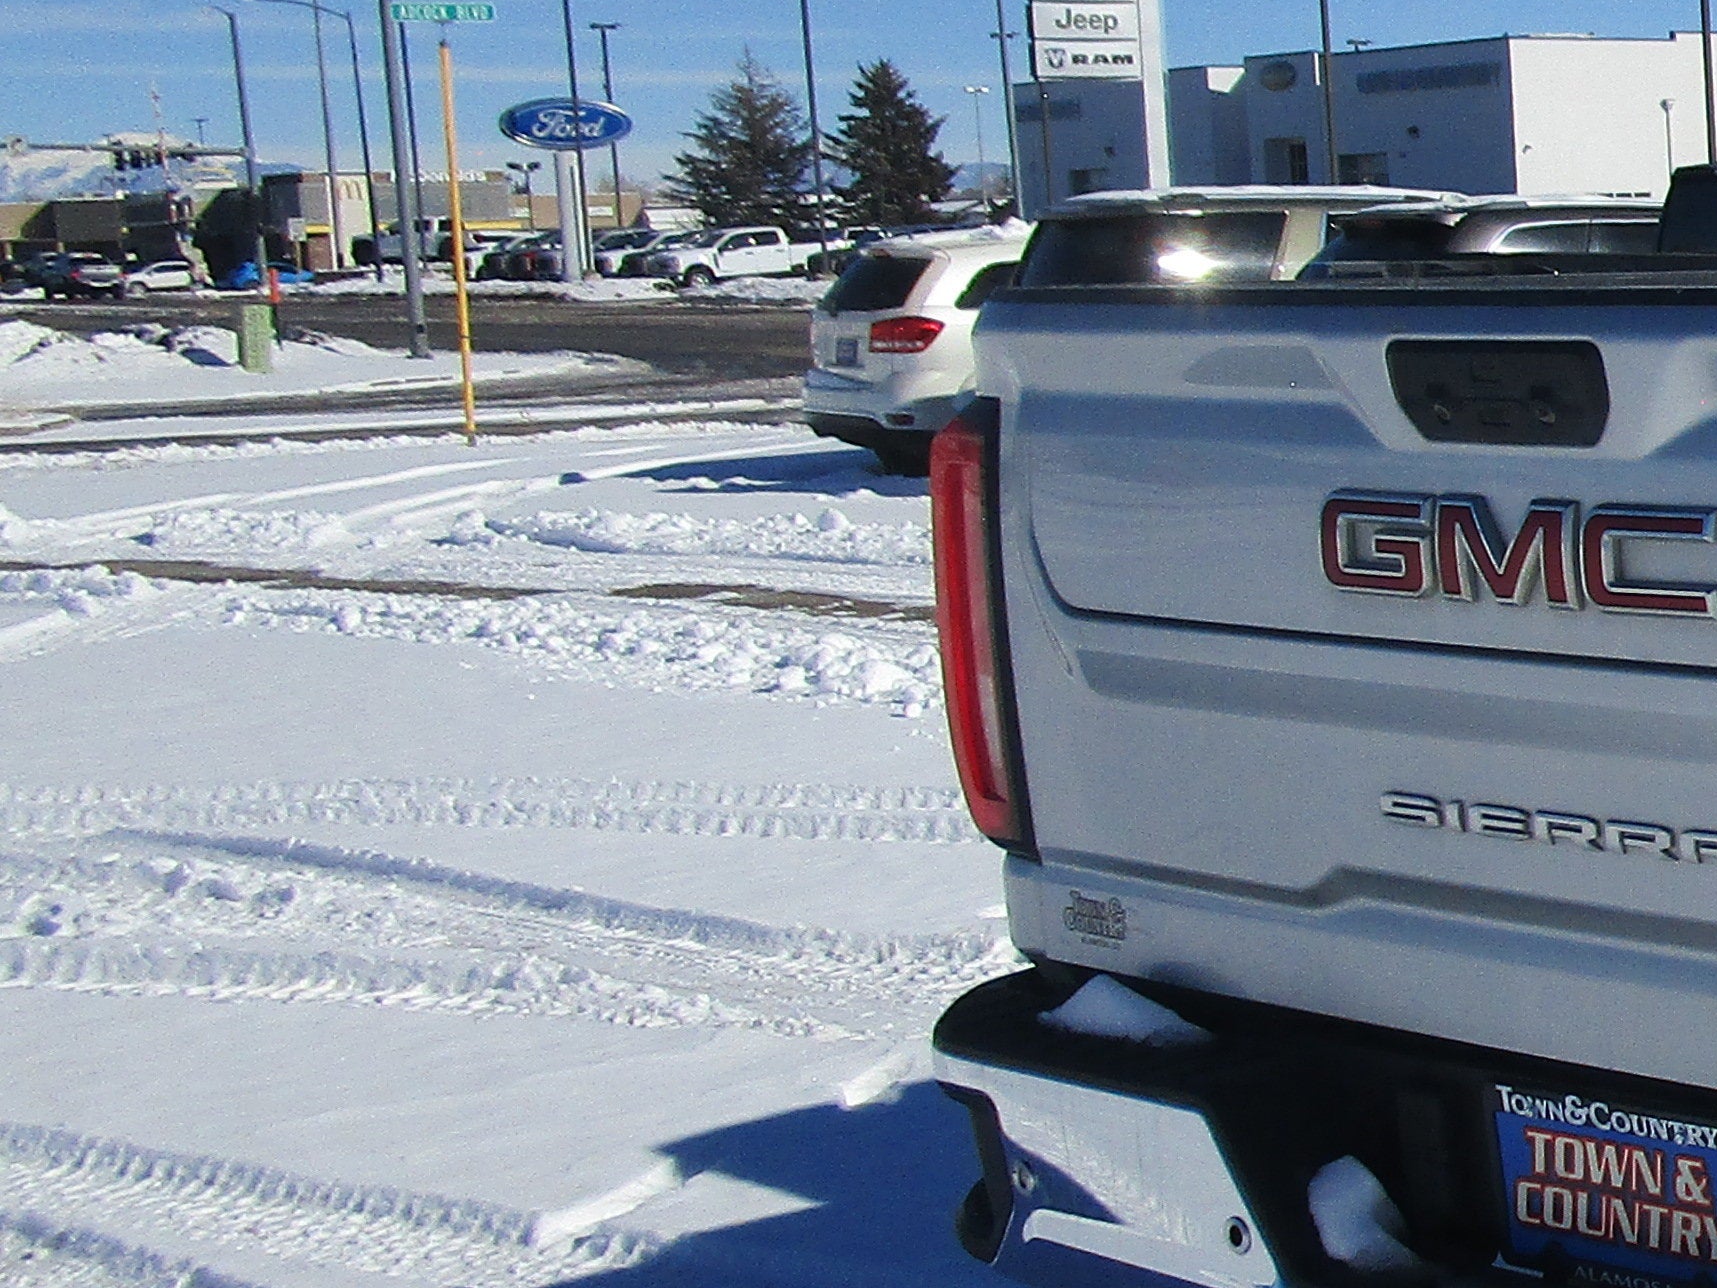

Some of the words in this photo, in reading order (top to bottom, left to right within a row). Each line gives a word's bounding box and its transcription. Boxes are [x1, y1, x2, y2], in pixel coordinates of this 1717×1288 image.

[1054, 7, 1119, 35] Jeep
[1070, 52, 1135, 66] RAM
[531, 109, 606, 138] Ford
[1524, 1125, 1663, 1199] TOWN
[1674, 1154, 1712, 1208] &
